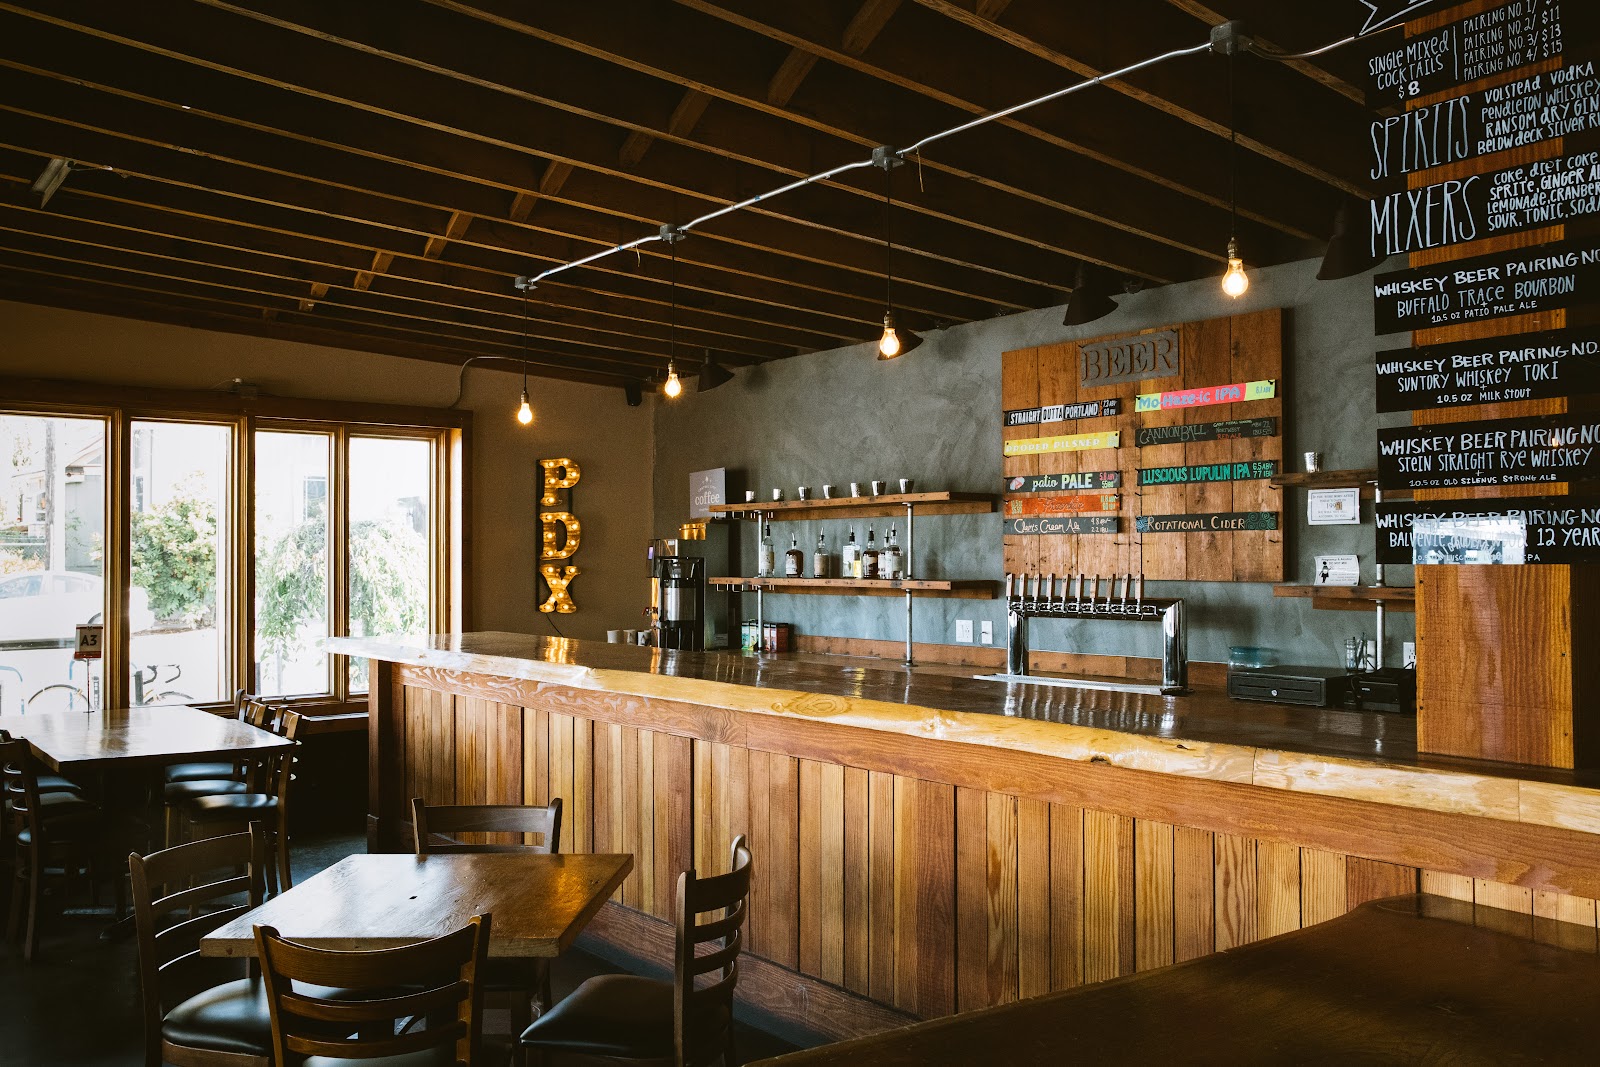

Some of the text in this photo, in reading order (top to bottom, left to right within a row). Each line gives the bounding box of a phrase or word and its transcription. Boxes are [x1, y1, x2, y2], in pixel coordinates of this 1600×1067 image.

[1464, 8, 1505, 34] PAIRING
[1464, 27, 1503, 51] PAIRING
[1542, 5, 1560, 24] $11
[1464, 42, 1504, 65] PAIRING
[1542, 23, 1561, 42] $13
[1464, 58, 1503, 82] PAIRING
[1543, 39, 1563, 57] $15
[1377, 54, 1444, 90] COCKTAILS
[1398, 80, 1421, 99] $8
[1485, 111, 1537, 138] RANSOM
[1573, 94, 1600, 116] GIN
[1370, 96, 1470, 180] SPIRITS
[1371, 175, 1480, 258] MIXERS
[1375, 276, 1448, 298] WHISKEY
[1454, 267, 1500, 285] BEER
[1506, 252, 1579, 278] PAIRING
[1397, 293, 1450, 318] BUFFALO
[1515, 275, 1575, 300] BOURBON
[1431, 313, 1448, 323] 10.5
[1464, 307, 1490, 319] PATIO
[1493, 304, 1515, 315] PALE
[1519, 300, 1538, 310] ALE
[1080, 336, 1175, 382] BEER
[1376, 358, 1447, 375] WHISKEY
[1451, 352, 1494, 369] BEER
[1499, 347, 1569, 365] PAIRING
[1398, 373, 1449, 393] SUNTORY
[1523, 361, 1558, 381] TOKI
[1215, 386, 1240, 401] IPA
[1437, 394, 1458, 404] 10.5
[1479, 391, 1501, 402] MILK
[1010, 410, 1041, 424] STRAIGHT
[1043, 406, 1063, 420] OUTTA
[1065, 403, 1098, 419] PORTLAND
[1005, 443, 1049, 453] PROPER
[1053, 438, 1100, 449] PILSNER
[1139, 425, 1207, 445] CANNONBALL
[1380, 435, 1455, 455] WHISKEY
[1460, 431, 1508, 450] BEER
[1510, 426, 1580, 449] PAIRING
[1438, 451, 1495, 471] STRAIGHT
[1032, 473, 1093, 492] patio PALE
[1142, 463, 1250, 484] LUSCIOUS LUPULIN IPA
[1409, 479, 1429, 487] 10.5
[1443, 478, 1458, 486] OLD
[1460, 476, 1498, 485] SILENUS
[1539, 473, 1557, 481] ALE
[694, 490, 720, 506] coffee
[1147, 516, 1245, 531] ROTATIONAL CIDER
[1376, 512, 1447, 529] WHISKEY
[1451, 511, 1501, 527] BEER
[1506, 509, 1579, 526] PAIRING
[1537, 528, 1555, 547] 12
[80, 634, 98, 647] A3
